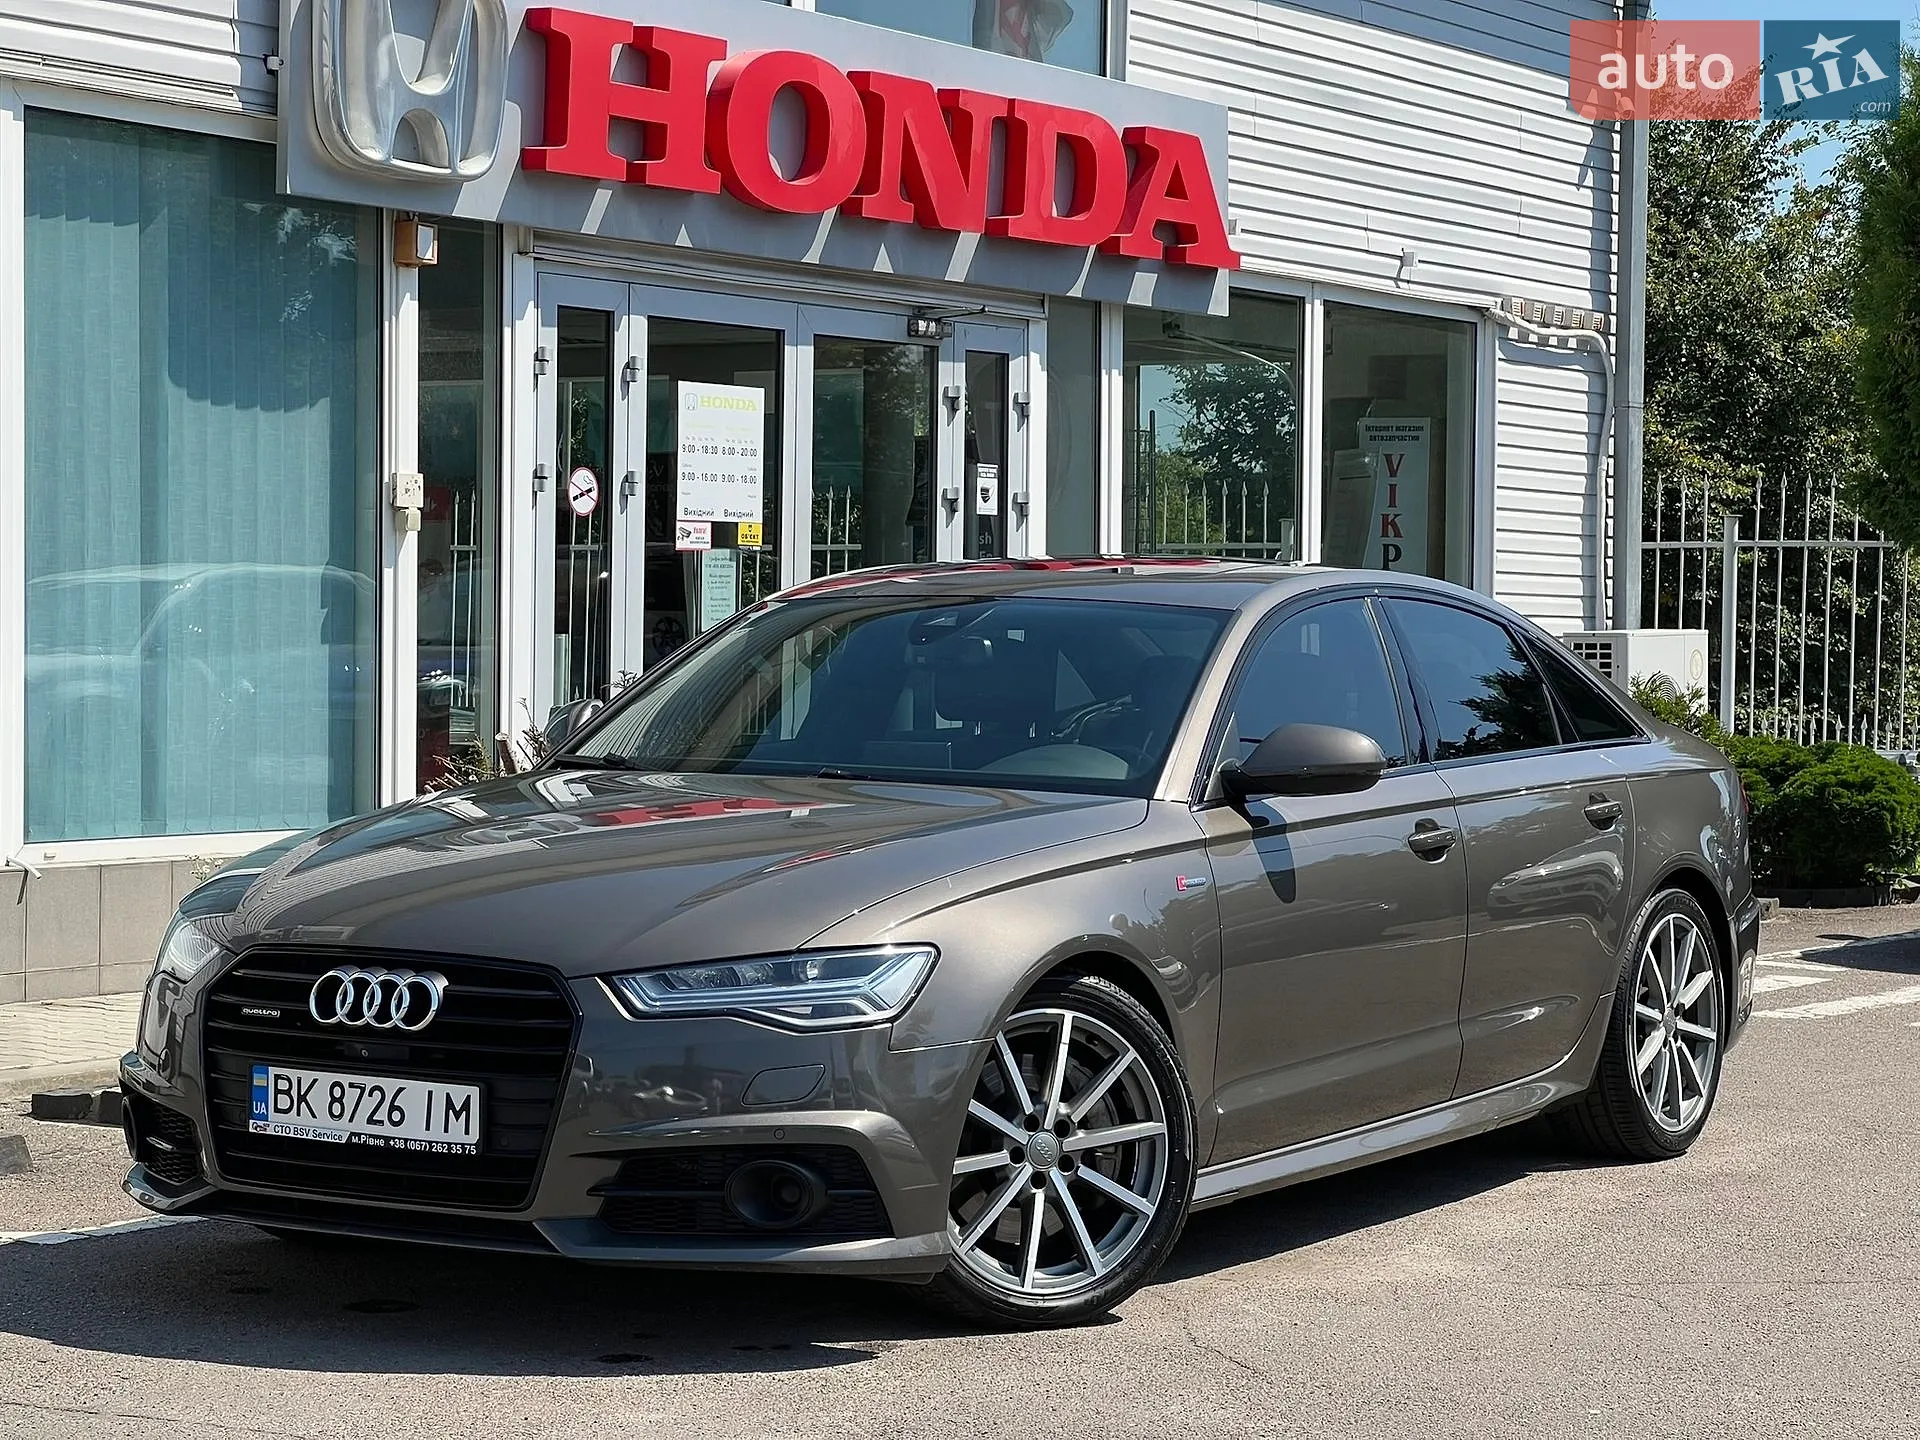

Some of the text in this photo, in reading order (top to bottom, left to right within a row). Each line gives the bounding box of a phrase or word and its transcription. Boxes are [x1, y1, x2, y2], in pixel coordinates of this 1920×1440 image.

[521, 7, 1241, 270] HONDA
[700, 395, 757, 412] HONDA
[683, 507, 715, 518] Вихідний
[723, 508, 754, 518] Вихідний
[242, 1008, 278, 1016] quattro
[253, 1101, 267, 1115] UA
[273, 1073, 319, 1119] BK
[328, 1081, 406, 1128] 8726
[273, 1125, 291, 1134] СТО
[293, 1127, 311, 1137] BSV
[312, 1129, 343, 1142] Service
[351, 1135, 477, 1155] м.Рівне +38 (067) 262 35 75
